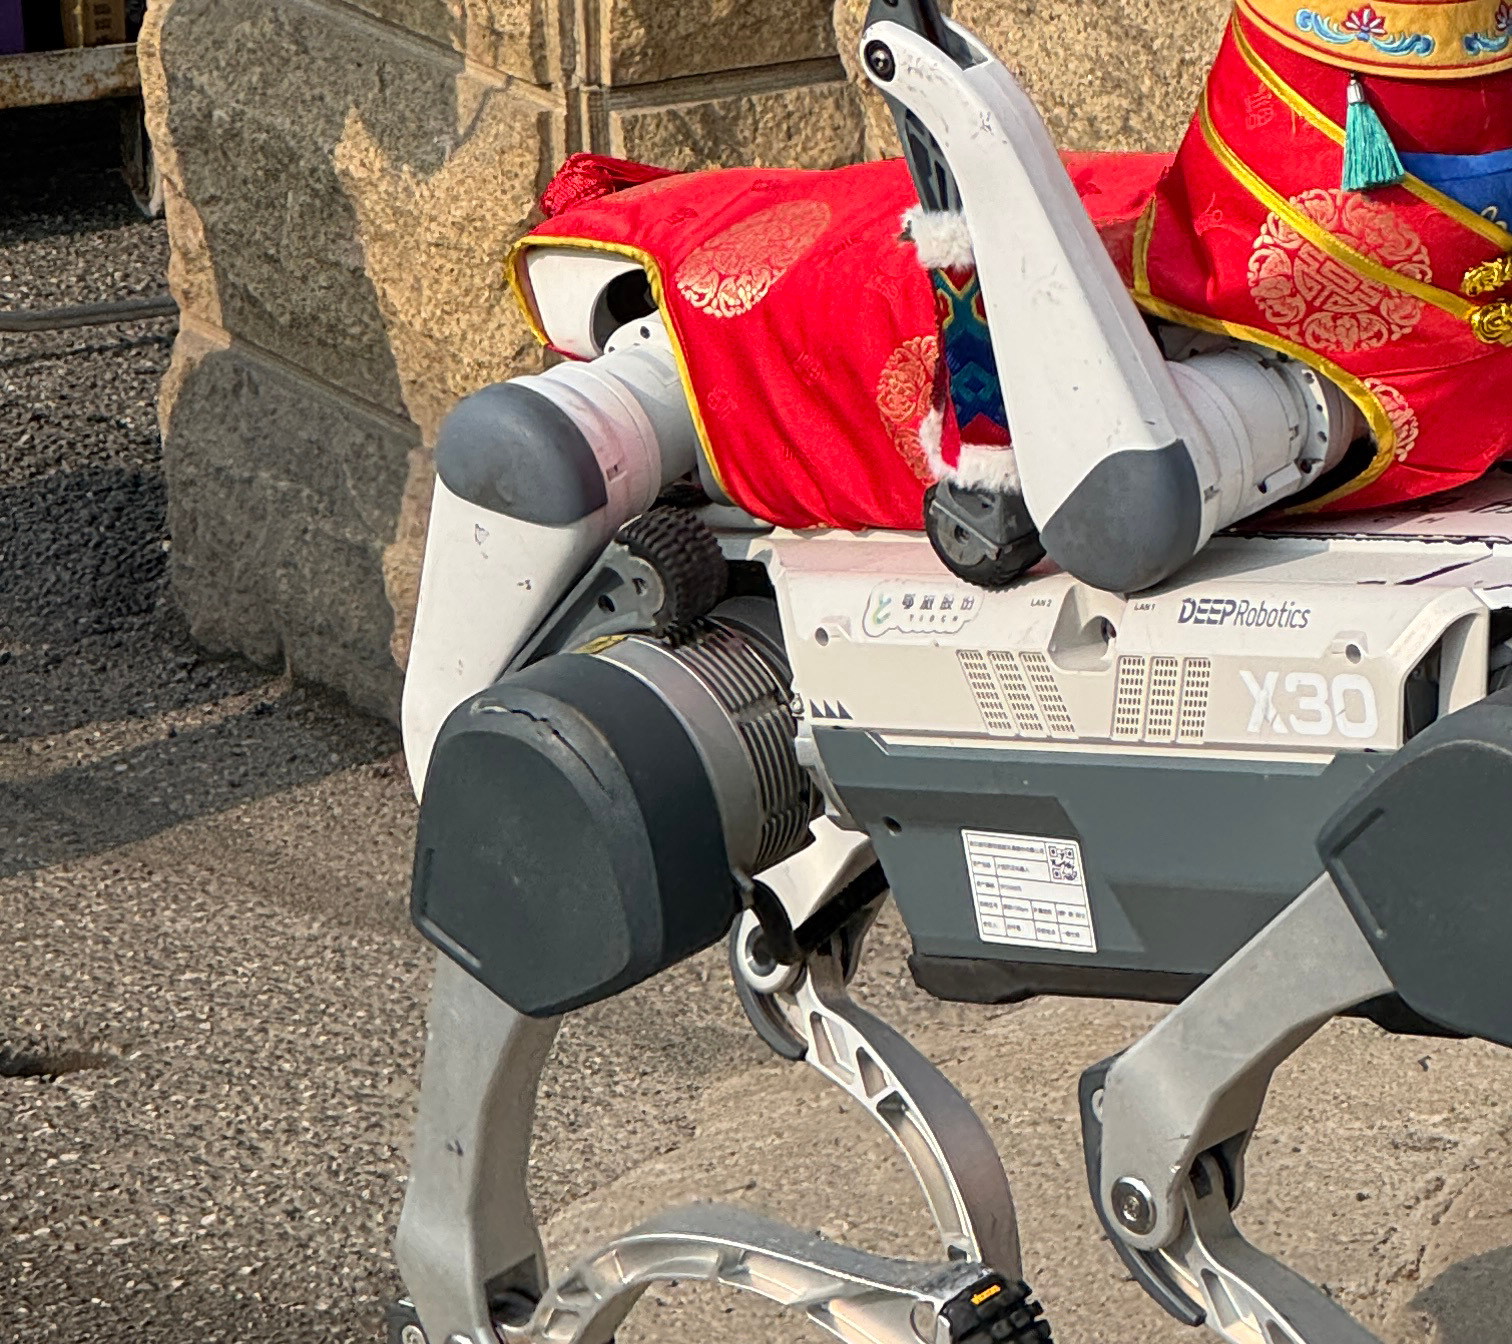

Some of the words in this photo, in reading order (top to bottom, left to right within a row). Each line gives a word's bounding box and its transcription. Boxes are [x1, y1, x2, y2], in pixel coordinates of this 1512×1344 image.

[1030, 599, 1045, 608] LAN
[1133, 603, 1150, 611] LAN
[1238, 669, 1379, 739] X30
